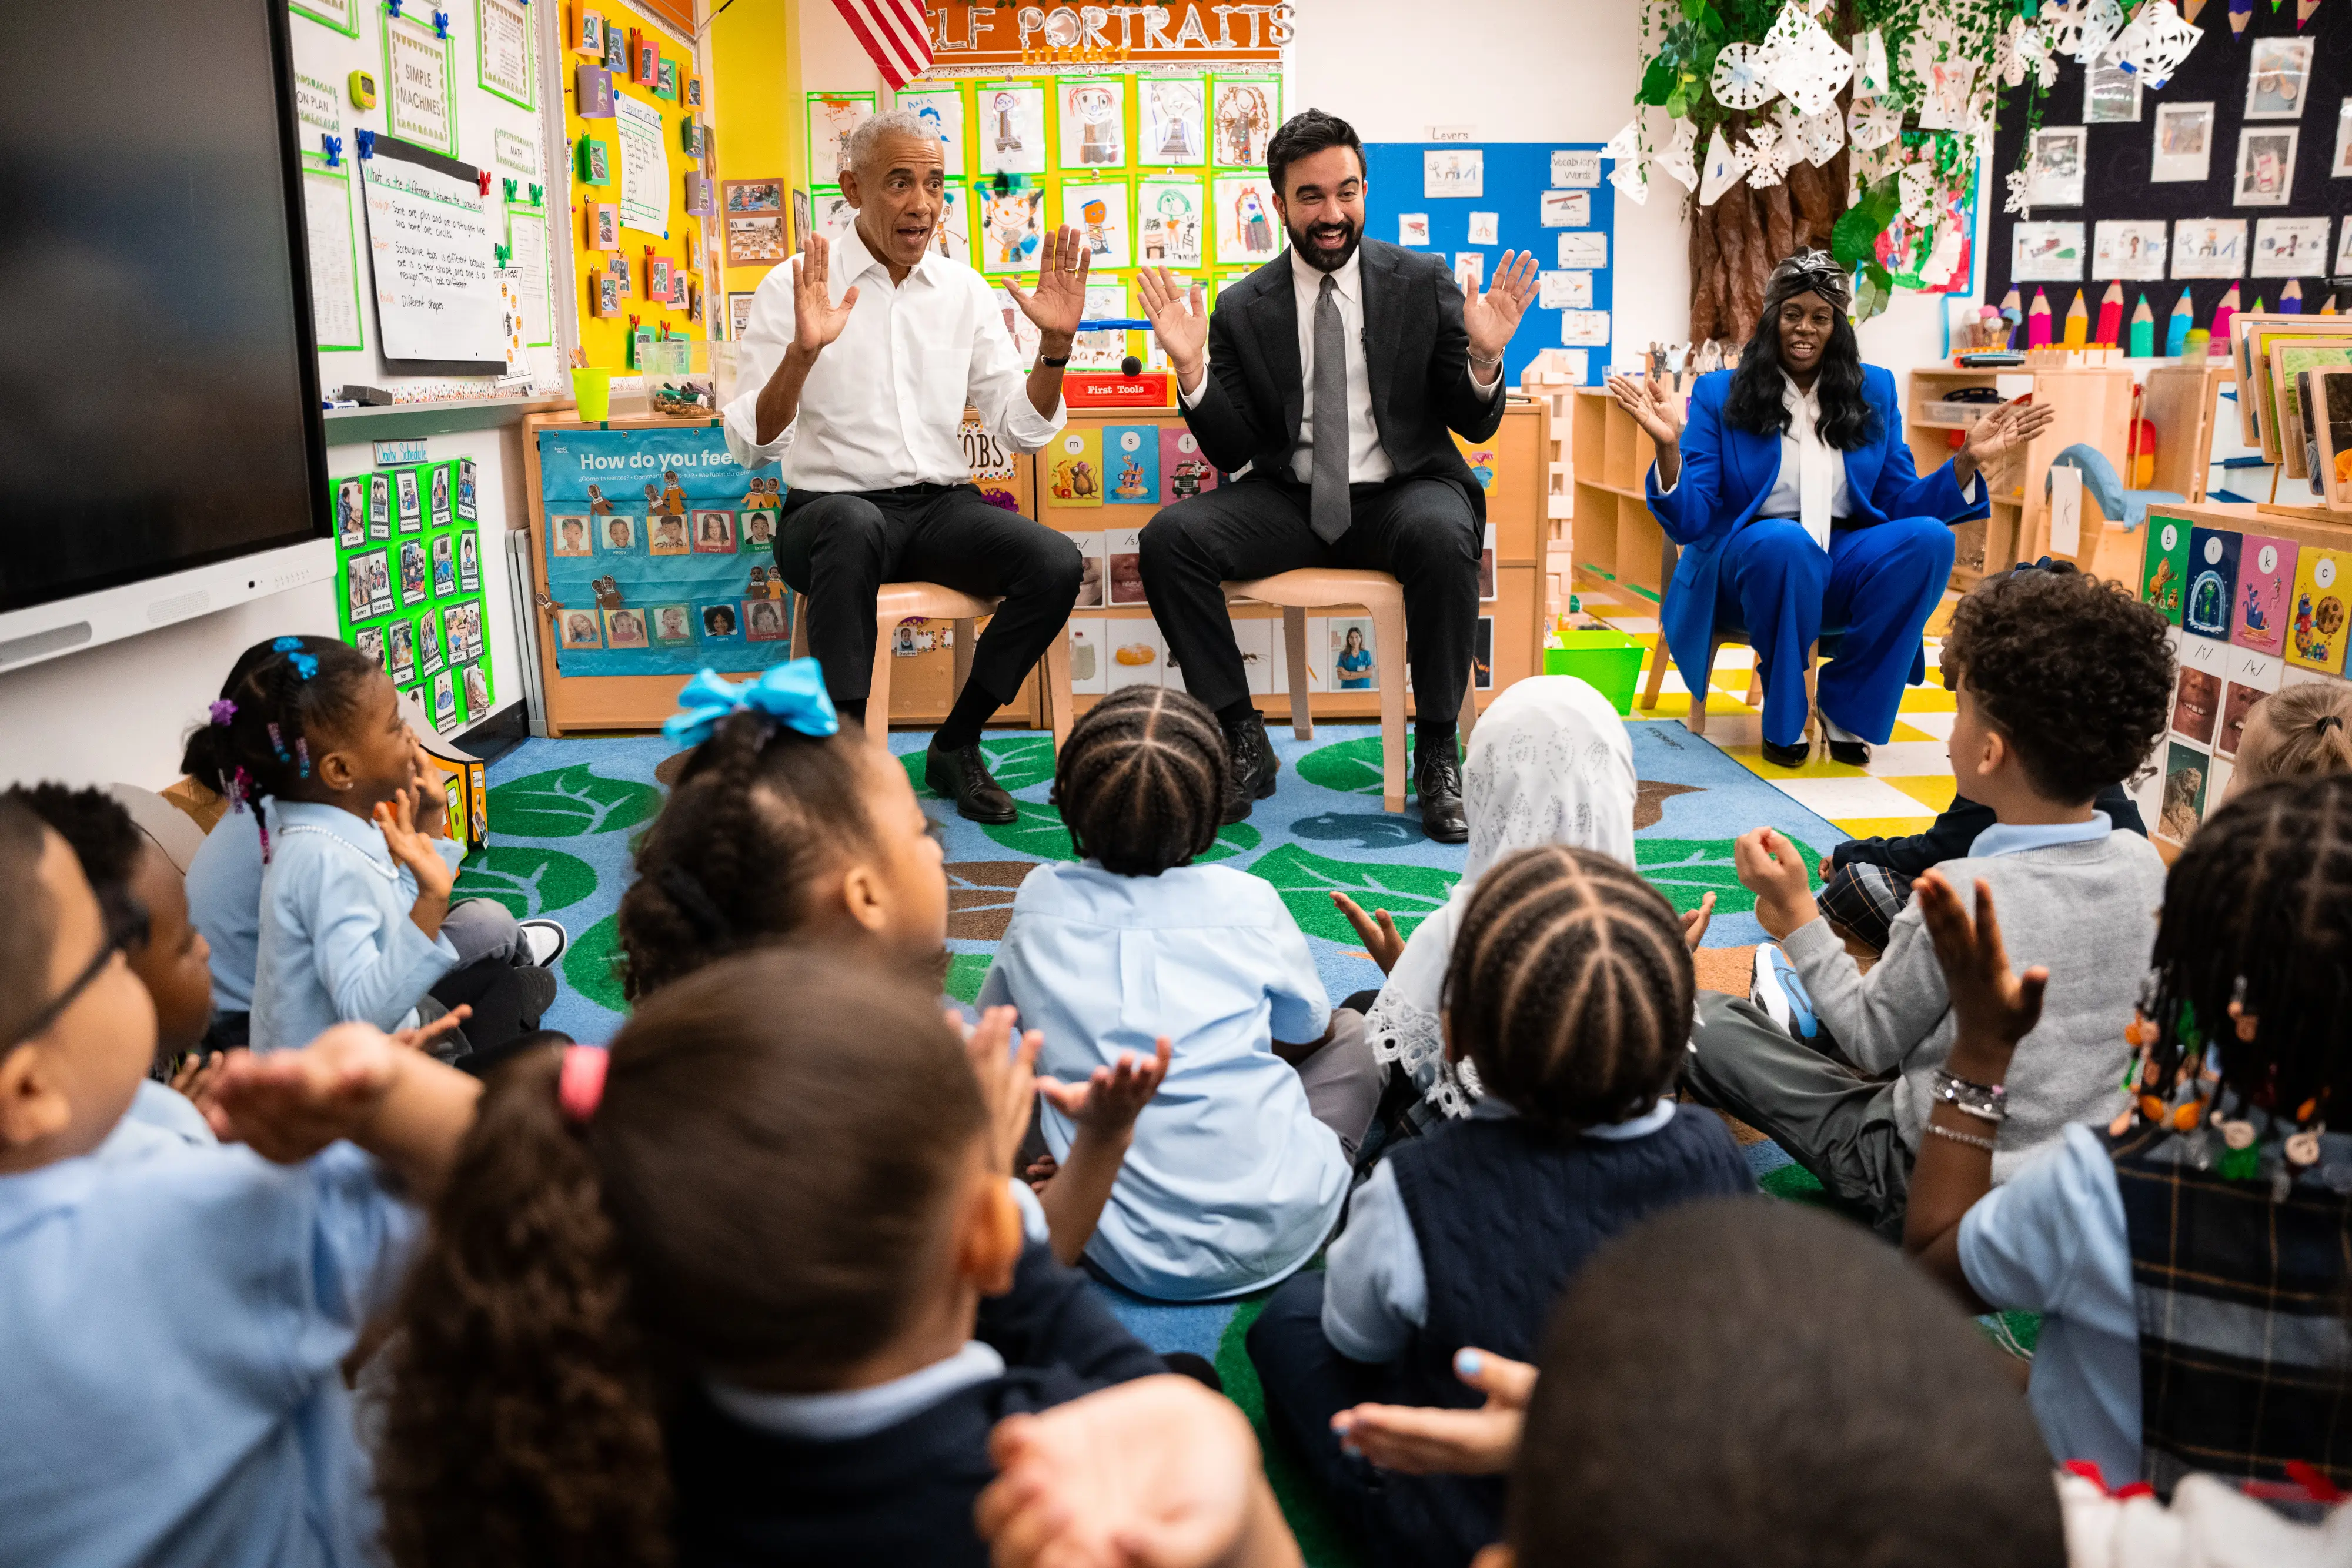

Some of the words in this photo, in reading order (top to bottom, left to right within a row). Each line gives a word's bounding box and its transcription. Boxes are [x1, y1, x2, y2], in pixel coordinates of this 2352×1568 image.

[1018, 3, 1295, 49] PORTRAITS
[1022, 45, 1132, 65] LITERACY
[406, 63, 432, 89] SIMPLE
[311, 95, 329, 113] PLAN
[400, 86, 440, 116] MACHINES
[1432, 127, 1468, 141] Levers
[510, 146, 522, 159] MATH
[1553, 158, 1597, 169] Vocabulary
[1564, 170, 1591, 180] Words
[364, 165, 383, 184] What
[386, 177, 391, 187] is
[393, 174, 403, 190] the
[406, 178, 430, 199] difference
[433, 188, 452, 204] between
[392, 200, 405, 216] Some
[409, 209, 417, 219] are
[420, 211, 430, 226] plus
[432, 214, 442, 224] and
[457, 219, 475, 238] straight
[396, 219, 405, 229] and
[408, 222, 420, 232] some
[396, 241, 424, 257] Screwdrive
[442, 253, 446, 262] is
[447, 252, 467, 265] different
[469, 256, 485, 270] because
[397, 259, 406, 268] one
[410, 260, 414, 269] is
[424, 263, 434, 272] star
[466, 269, 474, 279] one
[402, 295, 425, 309] Different
[1087, 386, 1112, 394] First
[1117, 385, 1144, 394] Tools
[957, 434, 1004, 469] OBS
[1185, 437, 1190, 449] t
[376, 443, 396, 462] Daily
[399, 442, 427, 462] Schedule
[580, 454, 624, 470] How
[629, 452, 654, 468] do
[658, 455, 697, 472] you
[701, 449, 738, 466] fee
[2166, 530, 2171, 545] b
[2212, 541, 2215, 554] i
[2264, 551, 2270, 567] k
[2321, 569, 2328, 577] c
[2242, 659, 2266, 676] /k/
